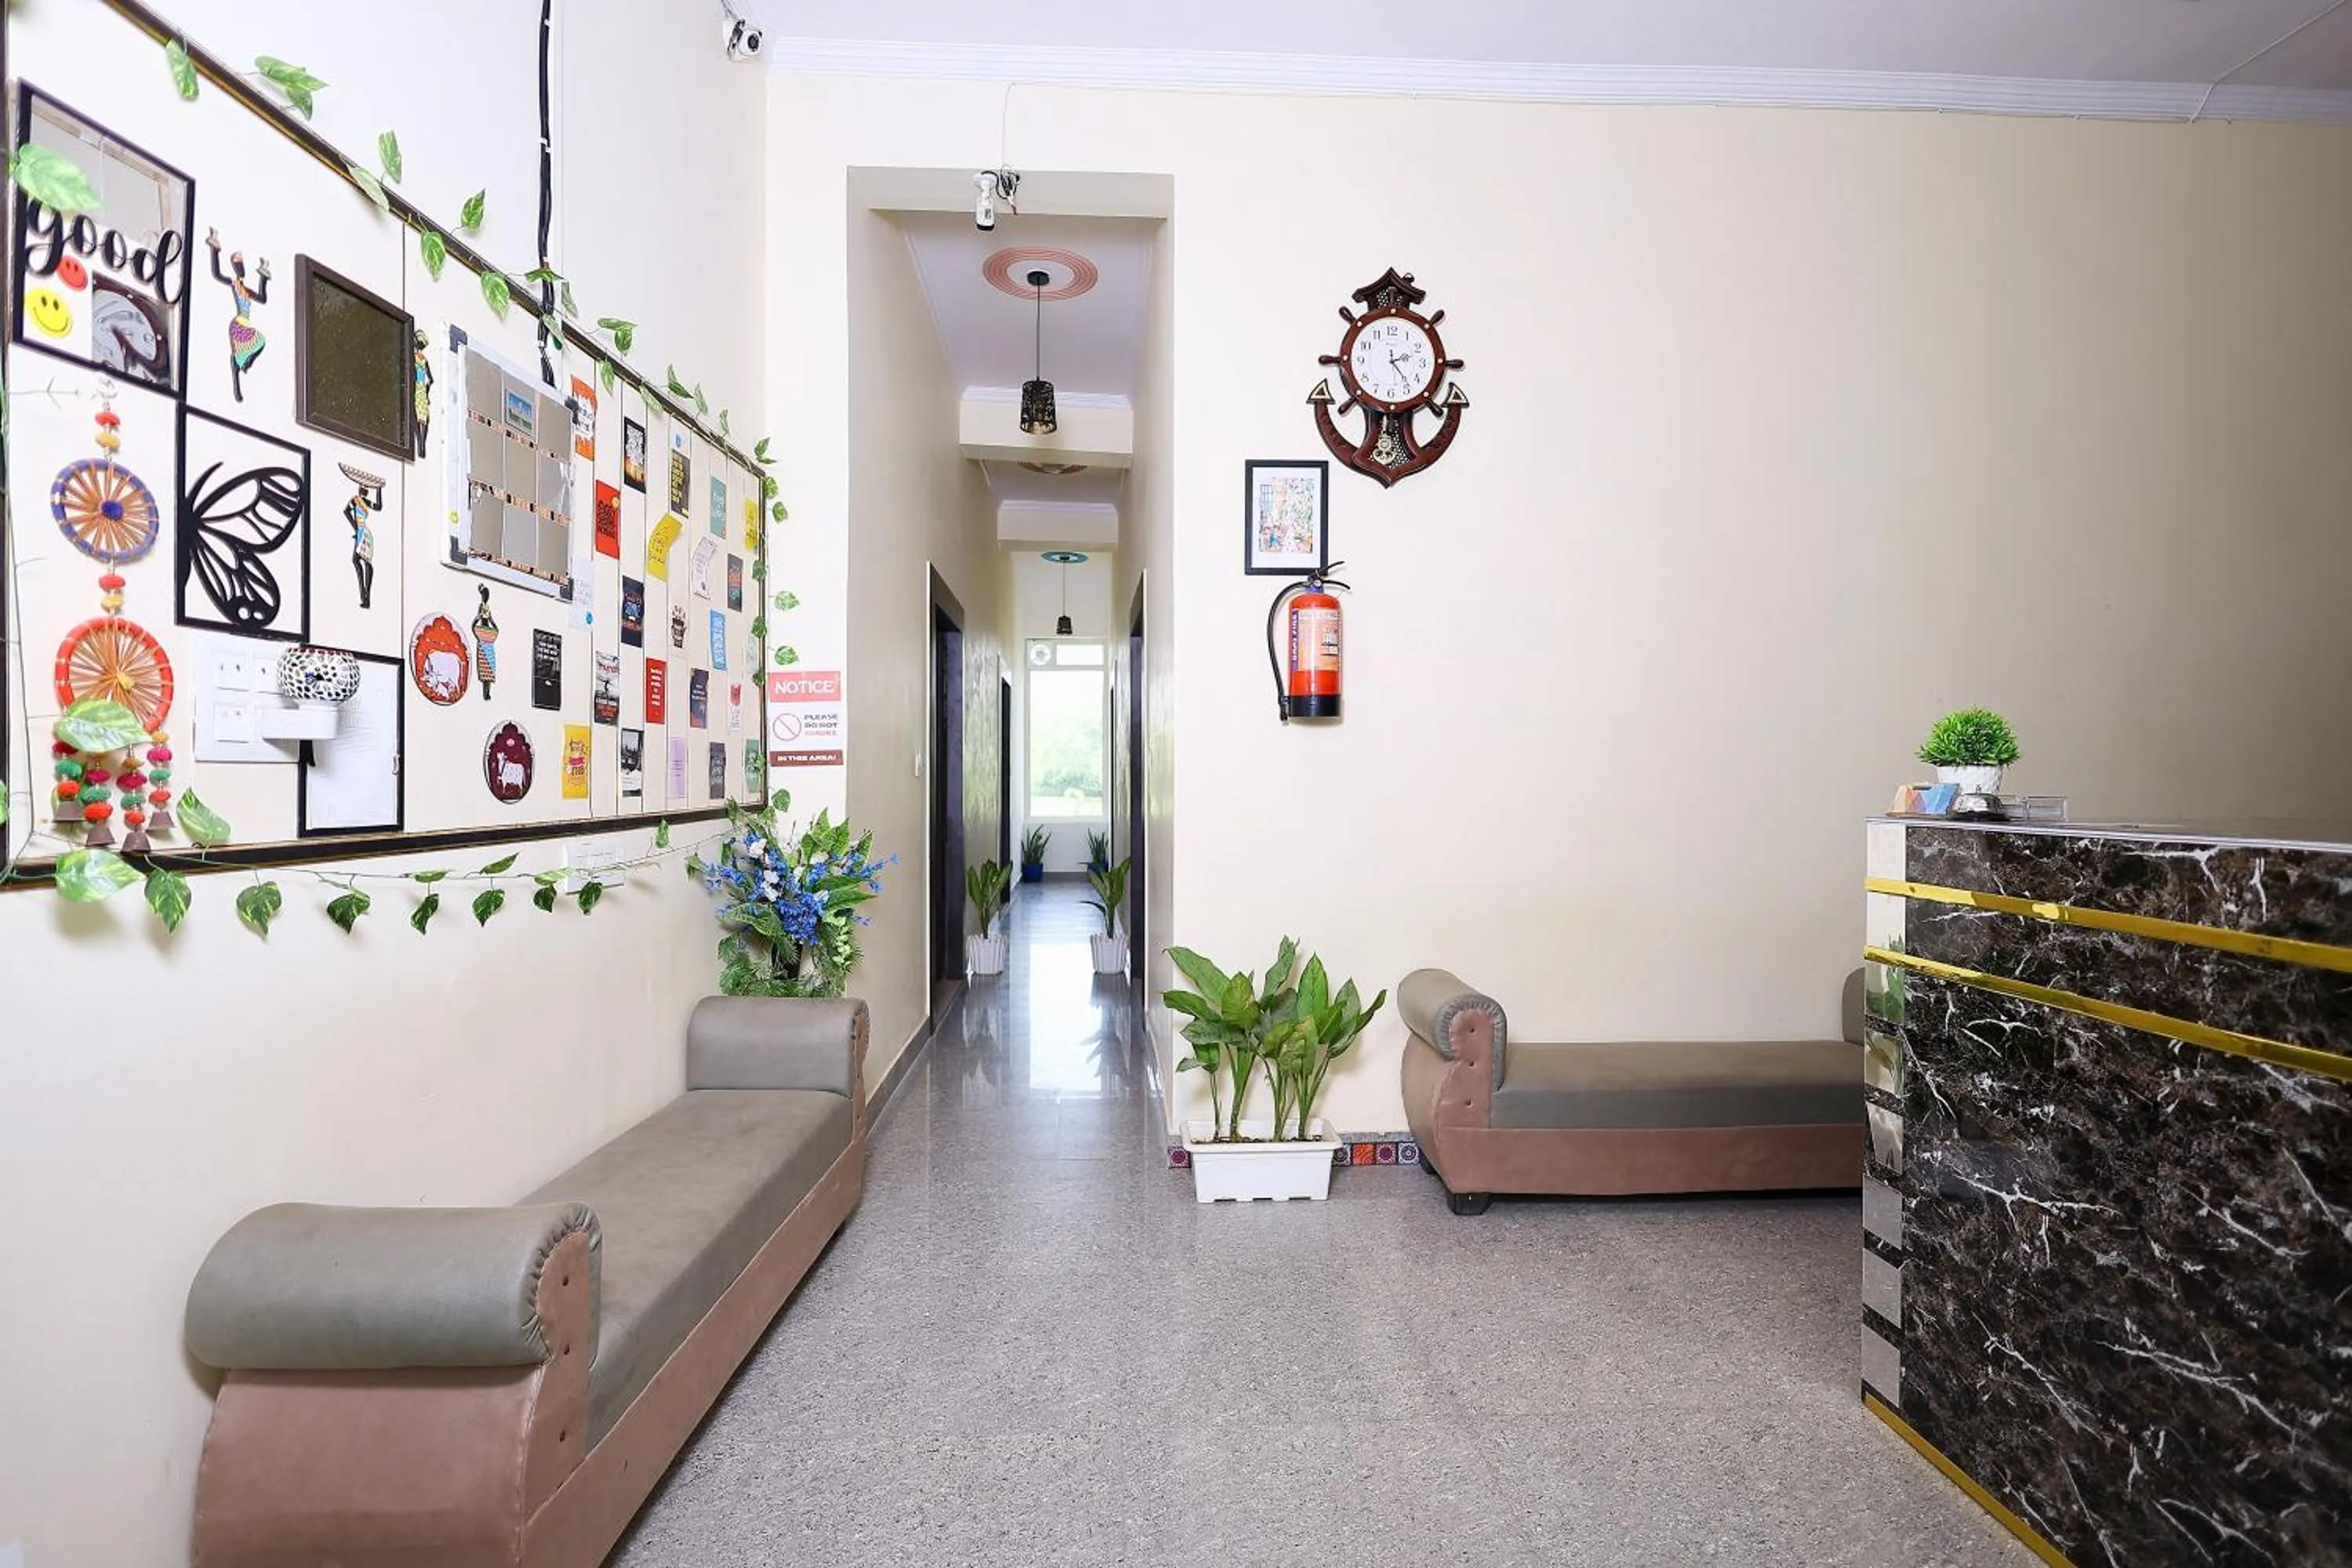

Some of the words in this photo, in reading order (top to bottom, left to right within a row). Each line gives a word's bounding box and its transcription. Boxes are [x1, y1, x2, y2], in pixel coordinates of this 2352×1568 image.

[25, 198, 183, 305] good
[1374, 330, 1381, 339] 11
[1387, 326, 1398, 336] 12
[1360, 341, 1371, 350] 10
[1414, 343, 1422, 353] 2
[1357, 356, 1365, 365] 9
[1418, 358, 1426, 368] 3
[1360, 373, 1370, 383] 8
[1414, 373, 1420, 383] 4
[1373, 383, 1379, 394] 7
[1387, 389, 1395, 398] 6
[1403, 384, 1410, 395] 5
[775, 680, 835, 695] NOTICE
